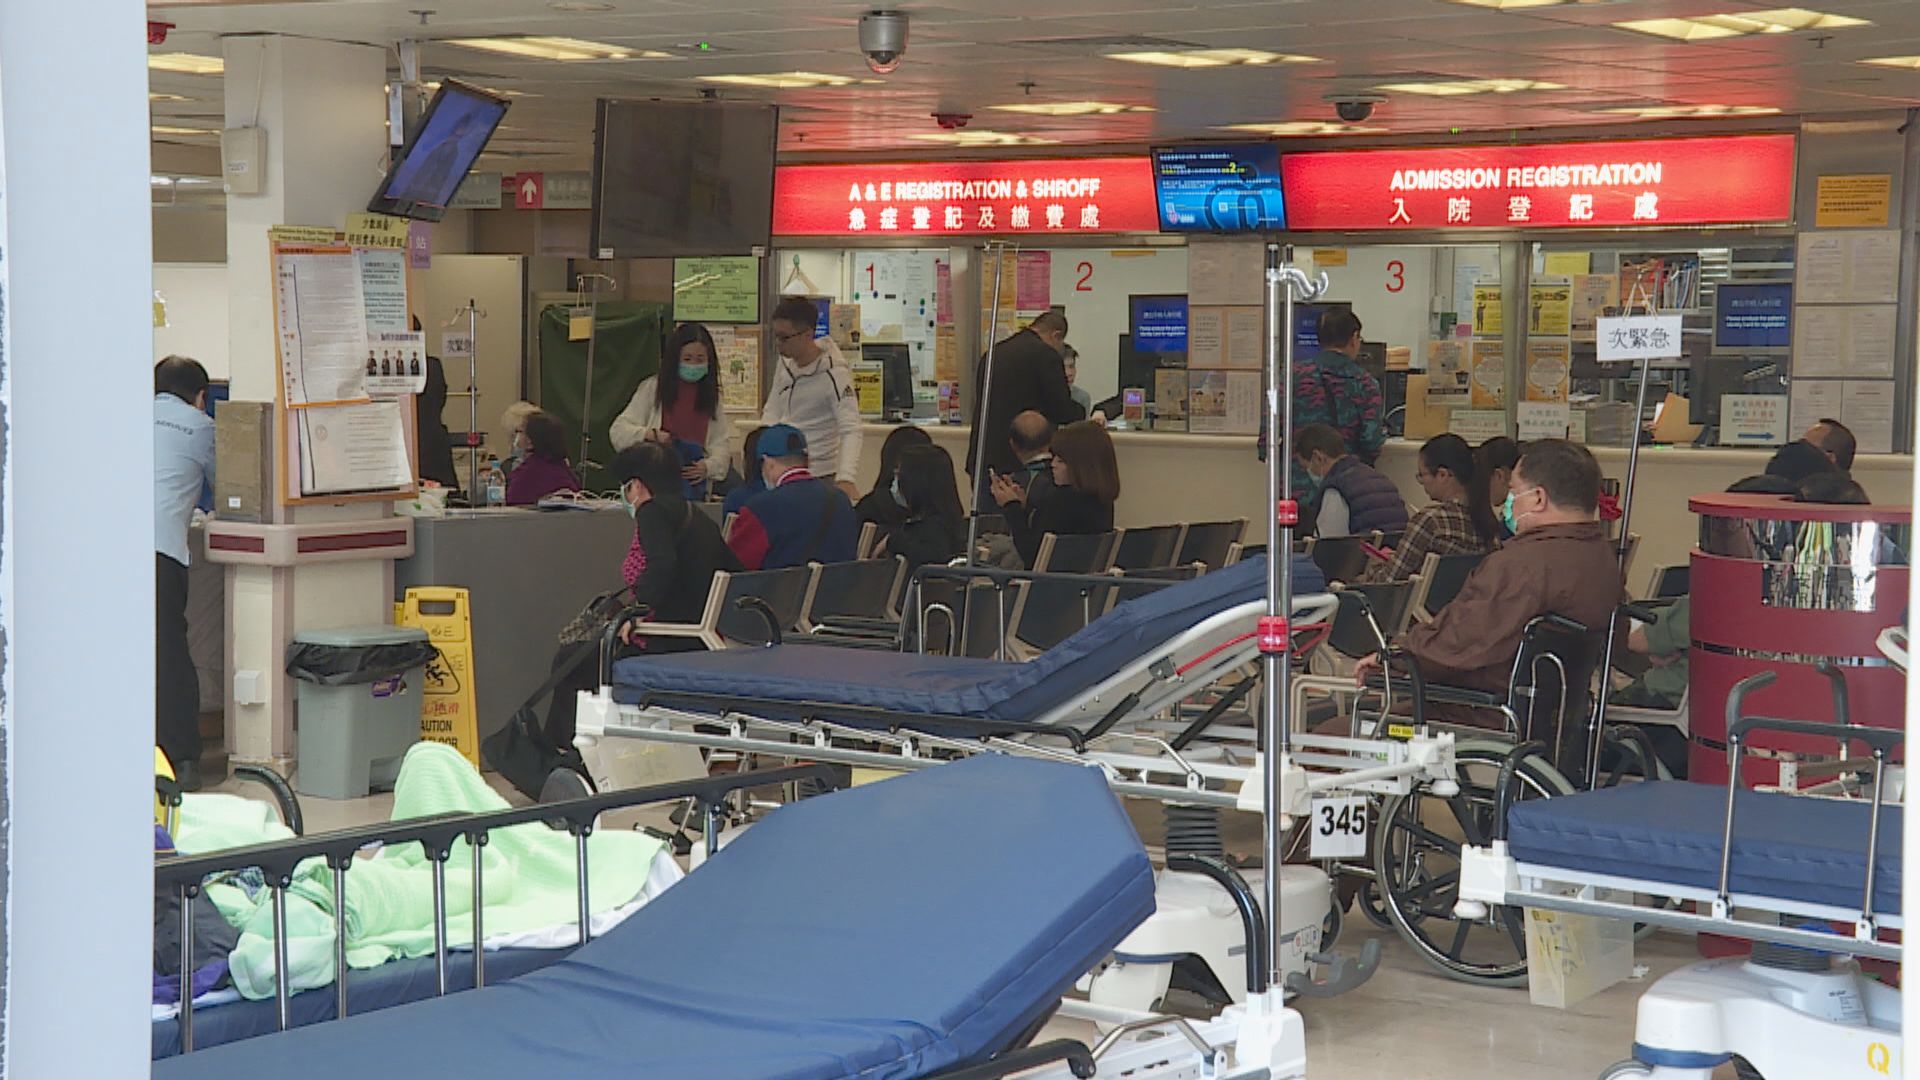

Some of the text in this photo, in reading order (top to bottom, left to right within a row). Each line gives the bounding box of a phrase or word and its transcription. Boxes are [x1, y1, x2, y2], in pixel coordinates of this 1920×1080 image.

[849, 178, 1100, 200] A & E REGISTRATION & SHROFF
[1389, 163, 1662, 191] ADMISSION REGISTRATION
[849, 203, 1099, 229] 急症登記及繳費處
[1389, 192, 1658, 223] 入院登記處
[866, 262, 875, 291] 1
[1075, 261, 1093, 292] 2
[1385, 260, 1405, 293] 3
[1608, 328, 1670, 349] 次緊急
[421, 719, 452, 732] AUTION
[1319, 804, 1366, 836] 345
[1866, 1042, 1890, 1076] Q
